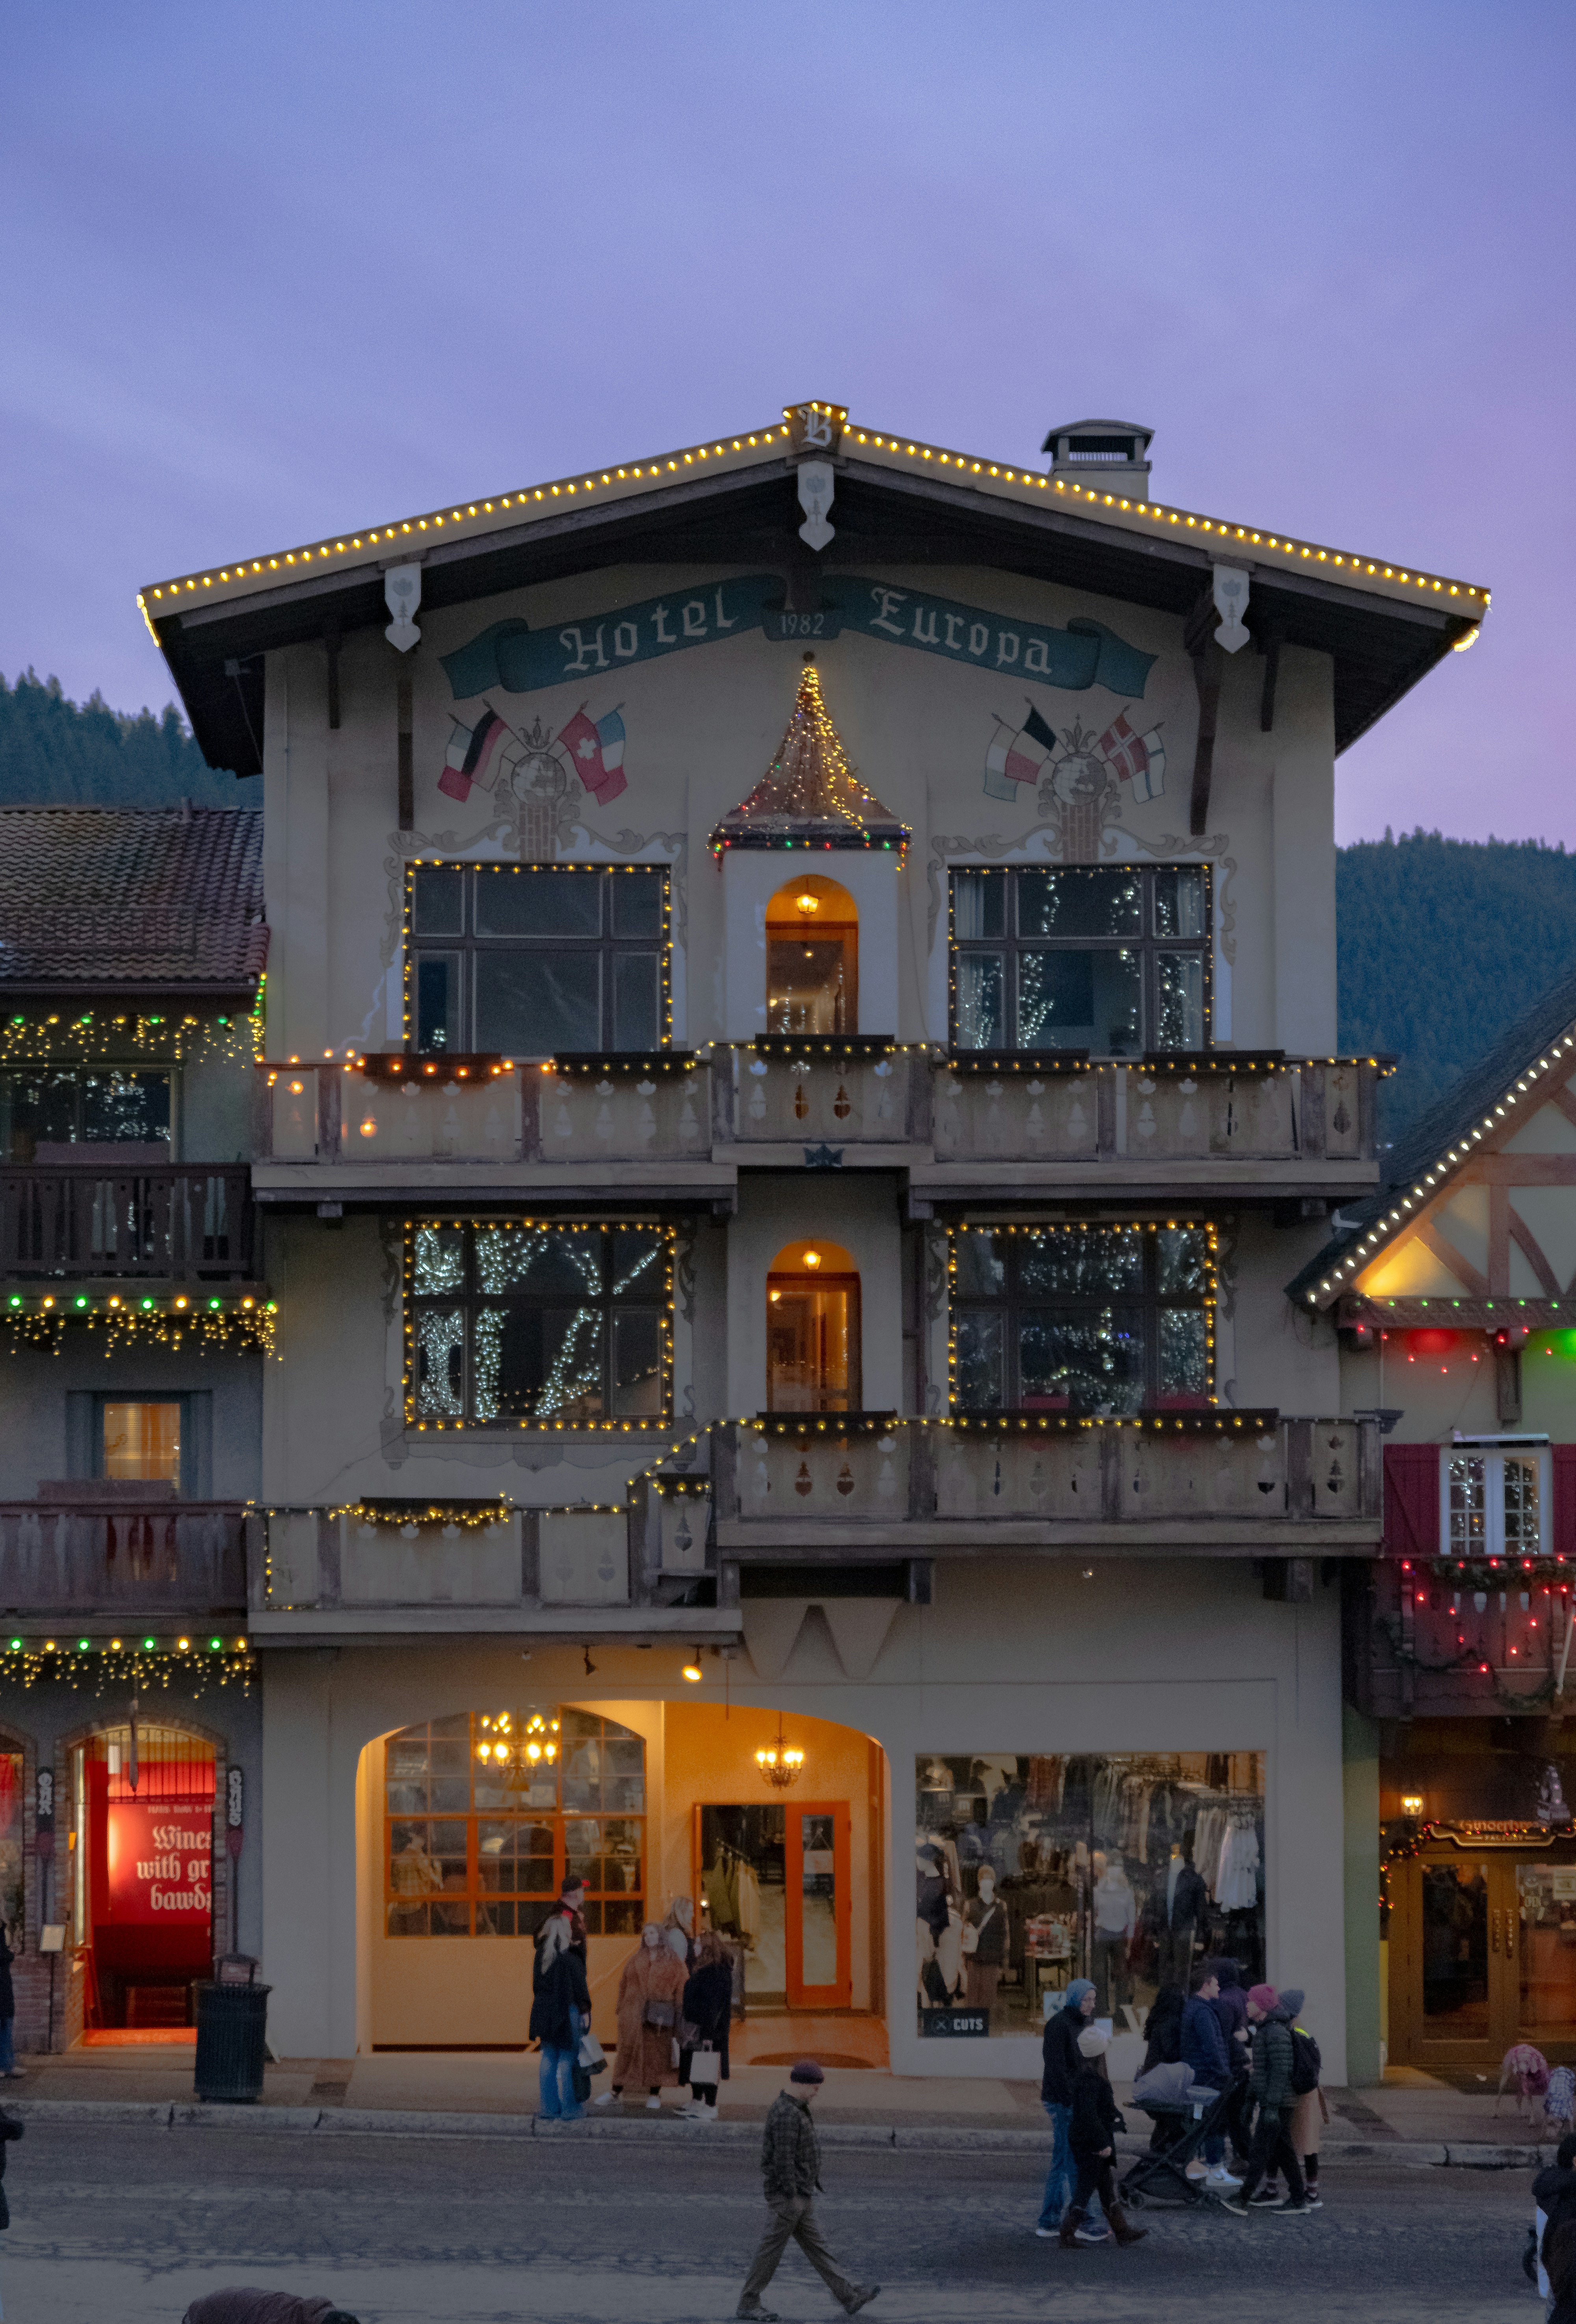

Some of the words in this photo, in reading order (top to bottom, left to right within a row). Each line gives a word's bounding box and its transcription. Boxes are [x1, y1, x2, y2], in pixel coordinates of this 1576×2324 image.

[559, 586, 739, 671] Hotel
[870, 587, 1052, 674] Europa
[781, 613, 824, 634] 1982
[136, 1852, 181, 1882] with
[953, 2018, 983, 2030] CUTS
